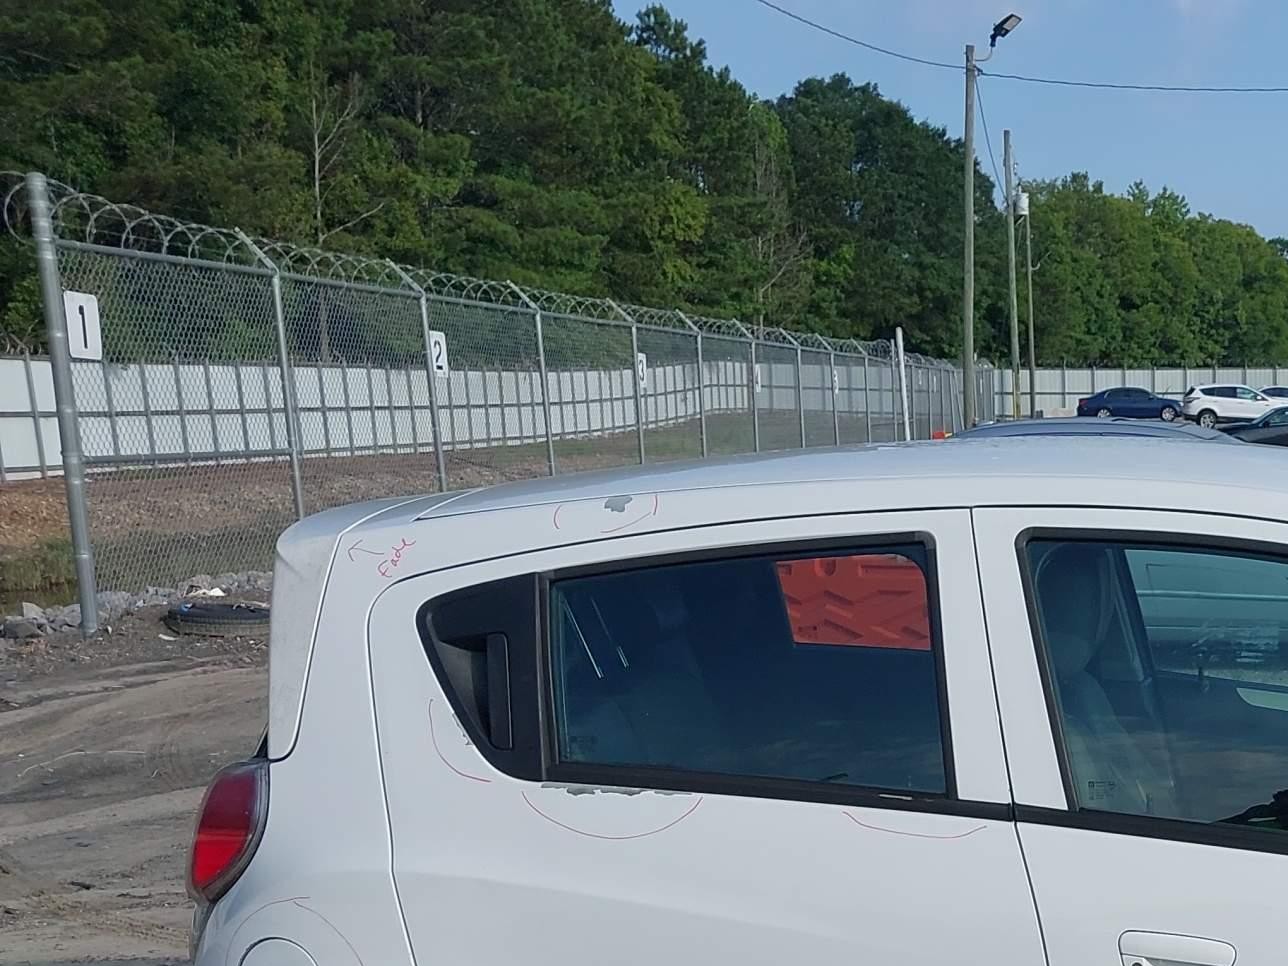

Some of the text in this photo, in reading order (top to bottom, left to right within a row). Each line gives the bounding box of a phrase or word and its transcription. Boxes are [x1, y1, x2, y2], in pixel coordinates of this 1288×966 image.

[78, 305, 88, 349] 1
[434, 340, 443, 370] 2
[638, 360, 645, 381] 3
[377, 538, 416, 577] Fade
